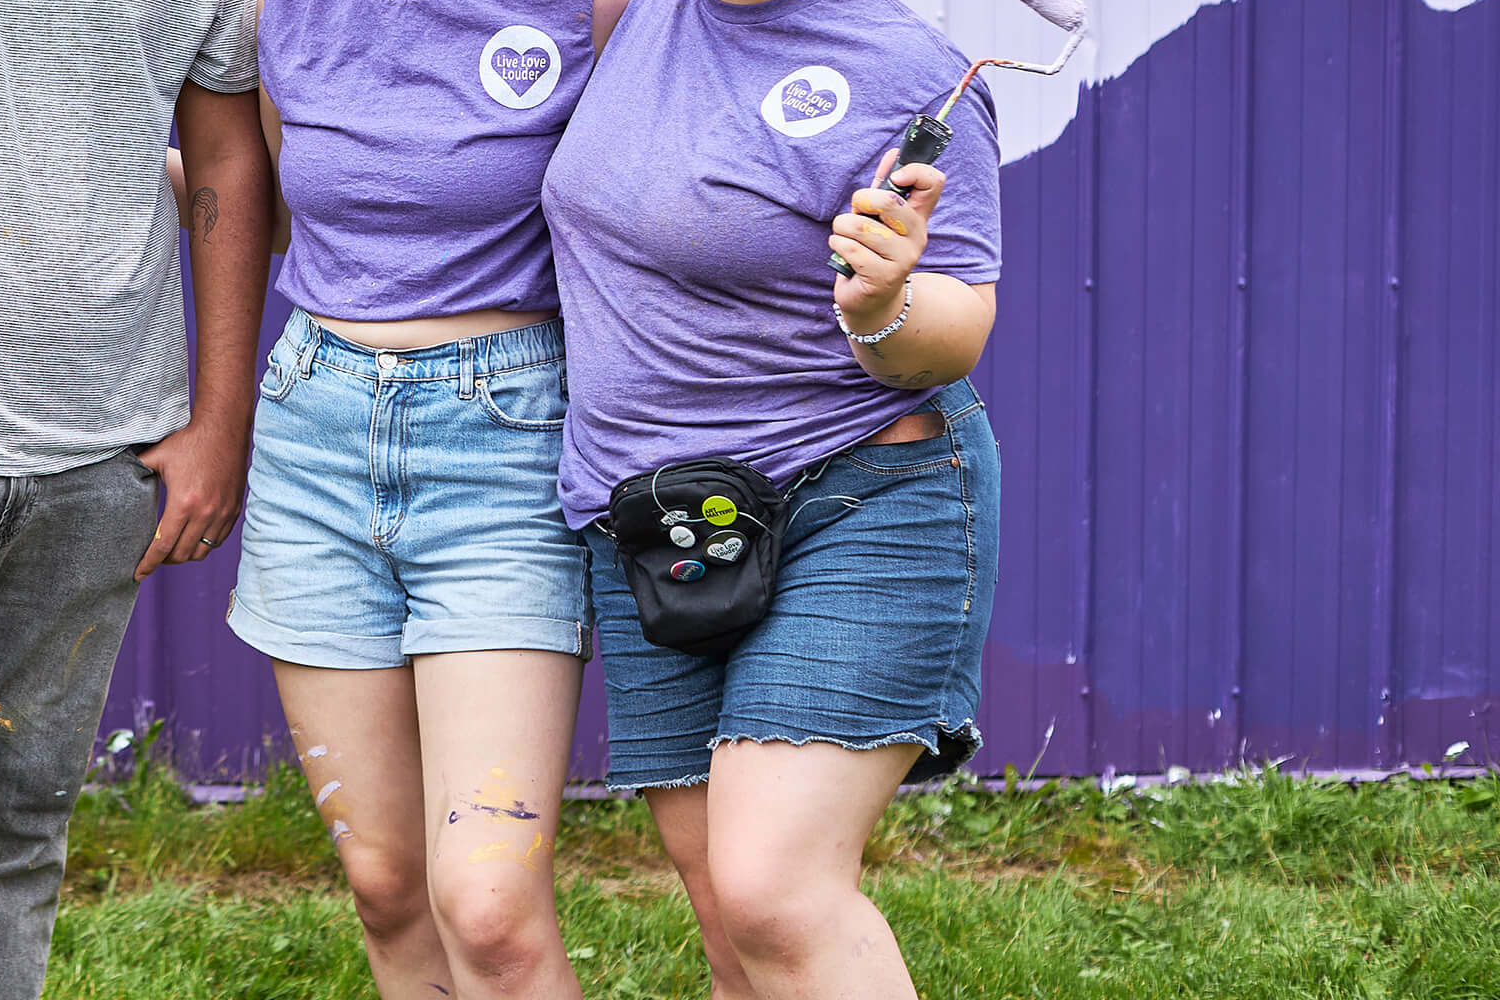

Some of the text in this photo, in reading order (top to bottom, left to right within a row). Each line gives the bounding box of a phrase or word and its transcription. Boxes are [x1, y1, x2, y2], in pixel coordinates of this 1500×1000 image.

[496, 54, 546, 68] Live Love
[502, 67, 540, 80] Louder
[782, 95, 821, 118] Louder
[786, 83, 833, 112] Live Love
